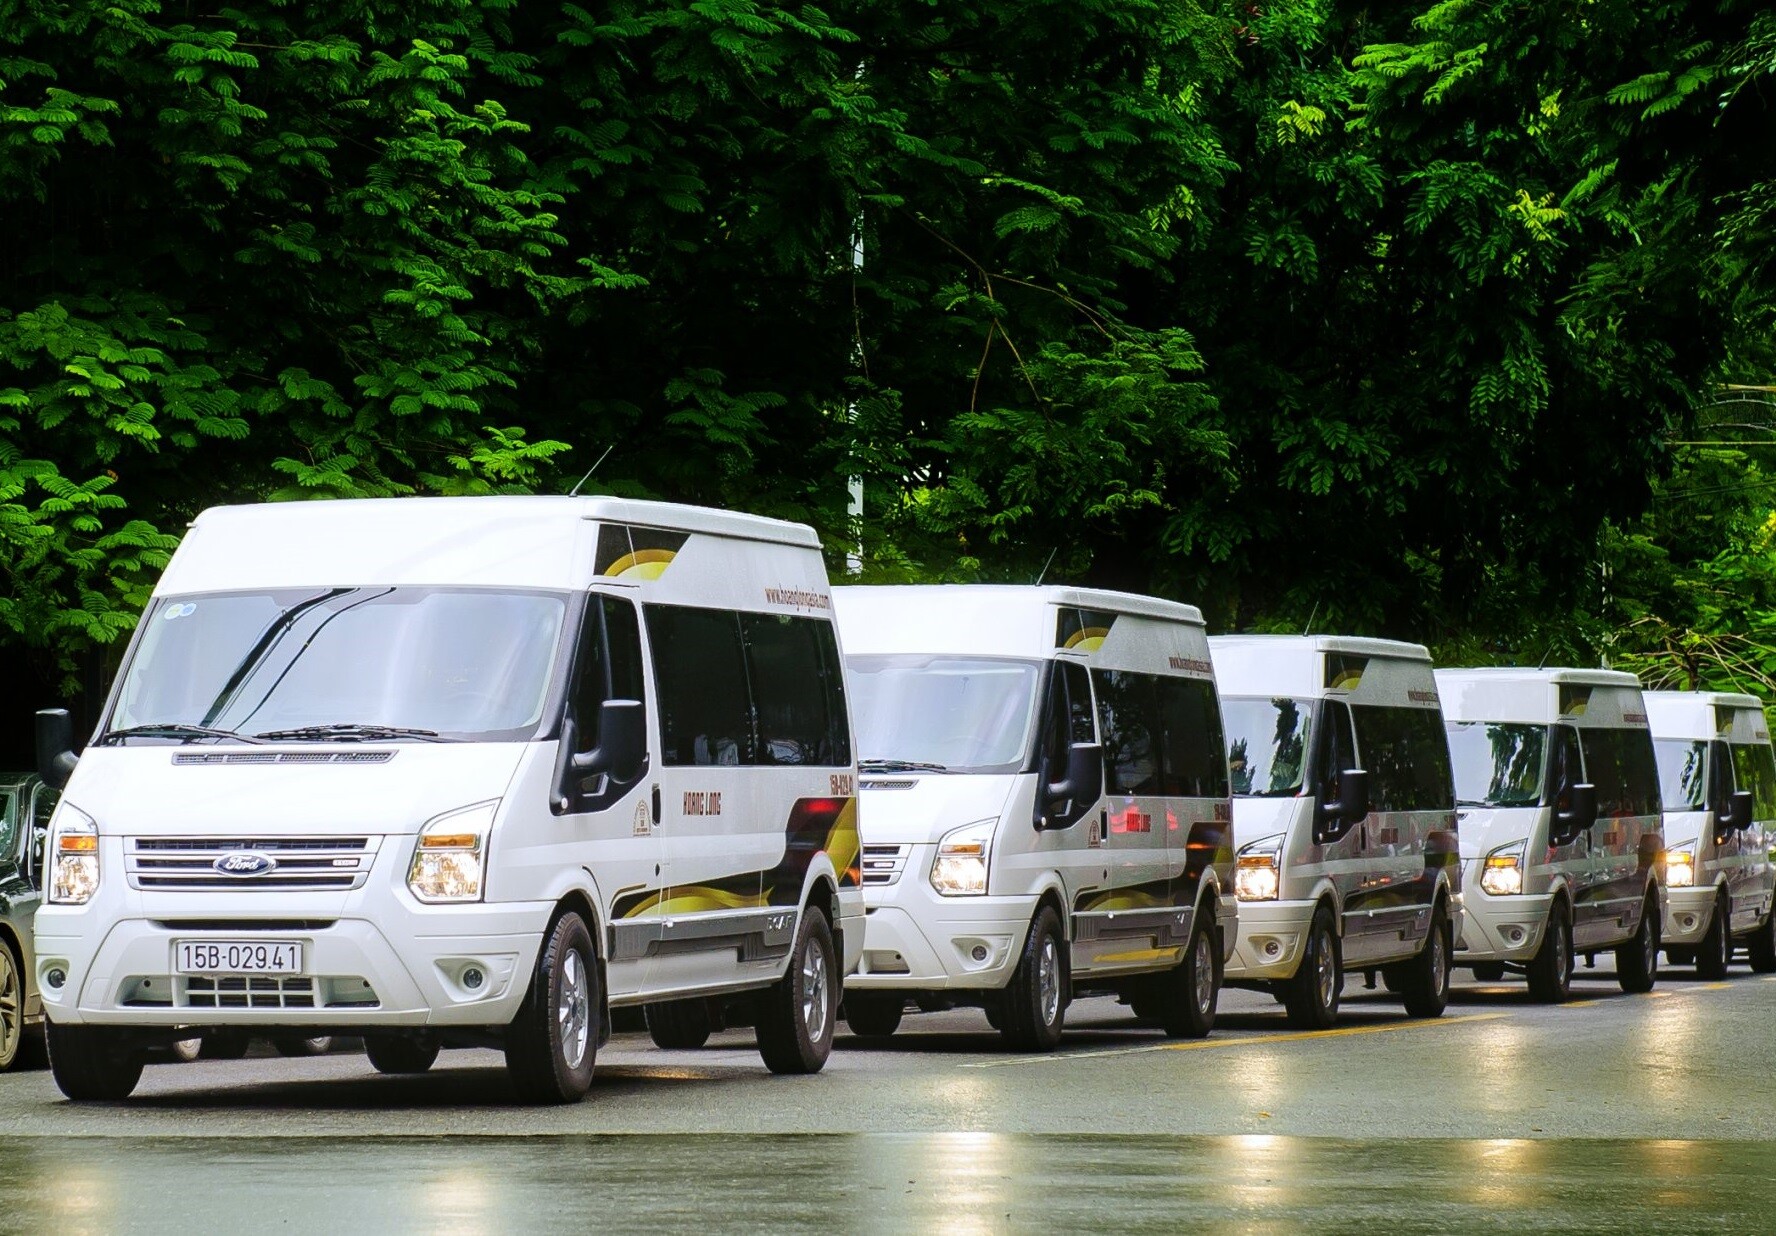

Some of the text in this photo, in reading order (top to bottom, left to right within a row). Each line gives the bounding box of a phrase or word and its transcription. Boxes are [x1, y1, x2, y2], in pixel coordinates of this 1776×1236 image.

[683, 791, 721, 816] HOANG LONG
[225, 855, 259, 871] Ford
[184, 945, 296, 970] 15B-029.41
